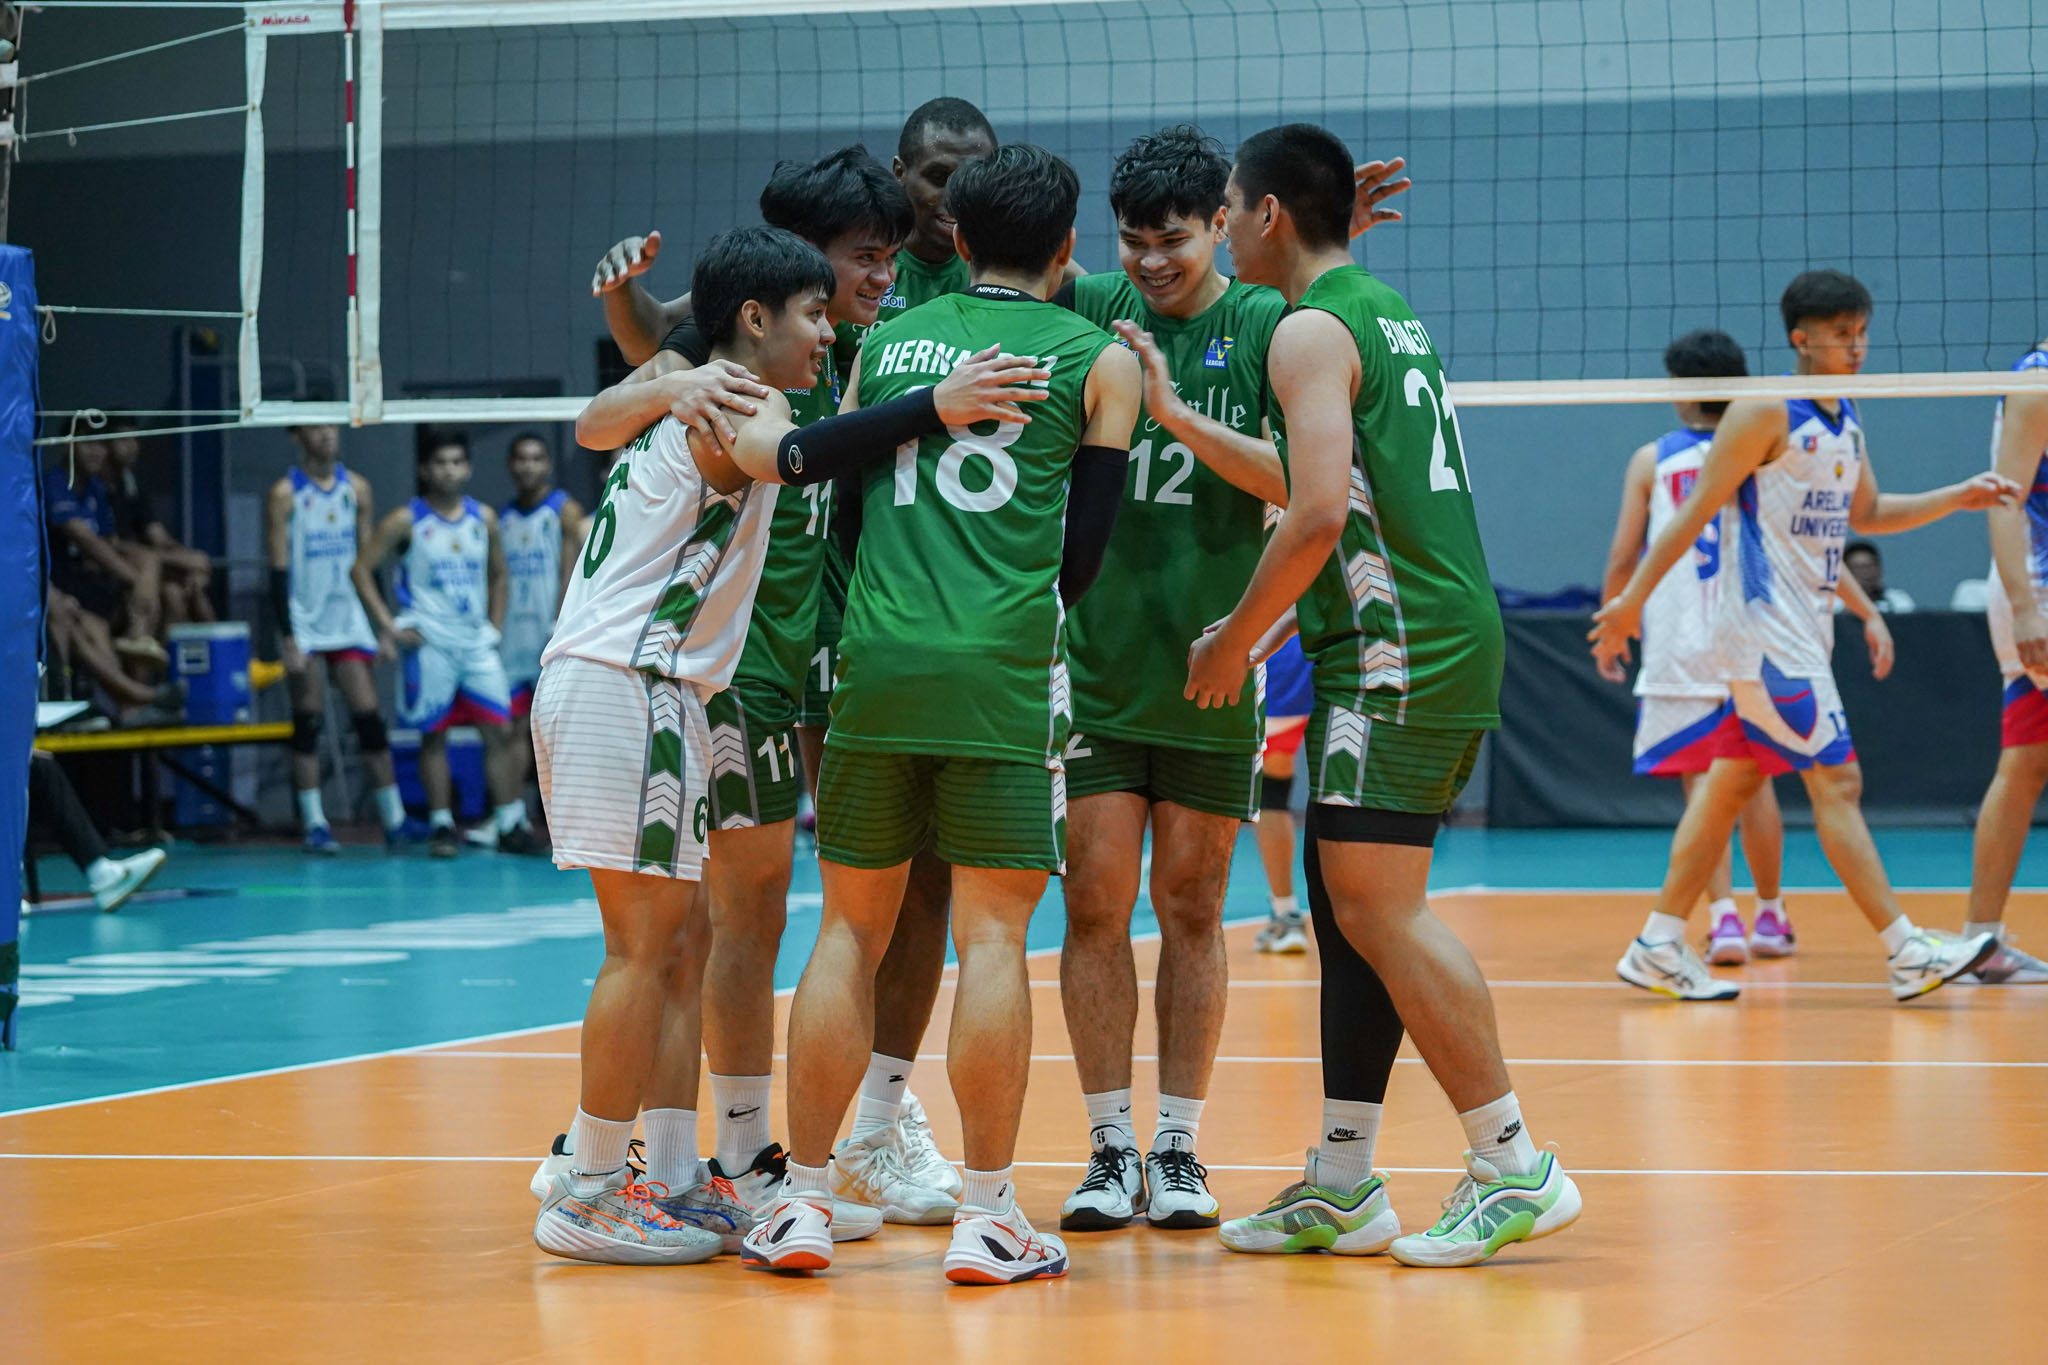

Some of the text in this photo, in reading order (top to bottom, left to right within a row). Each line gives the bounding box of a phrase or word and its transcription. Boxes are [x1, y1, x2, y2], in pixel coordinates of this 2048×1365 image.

[261, 14, 312, 26] MIKASA
[976, 285, 1020, 297] NIKE PRO
[1205, 358, 1226, 368] LEAGUE
[893, 386, 1026, 513] 18
[1403, 367, 1472, 493] 21
[1128, 438, 1195, 506] 12
[583, 461, 631, 580] 6
[801, 478, 833, 540] 11
[757, 732, 795, 783] 11
[693, 796, 708, 844] 6
[1333, 1127, 1358, 1138] NIKE
